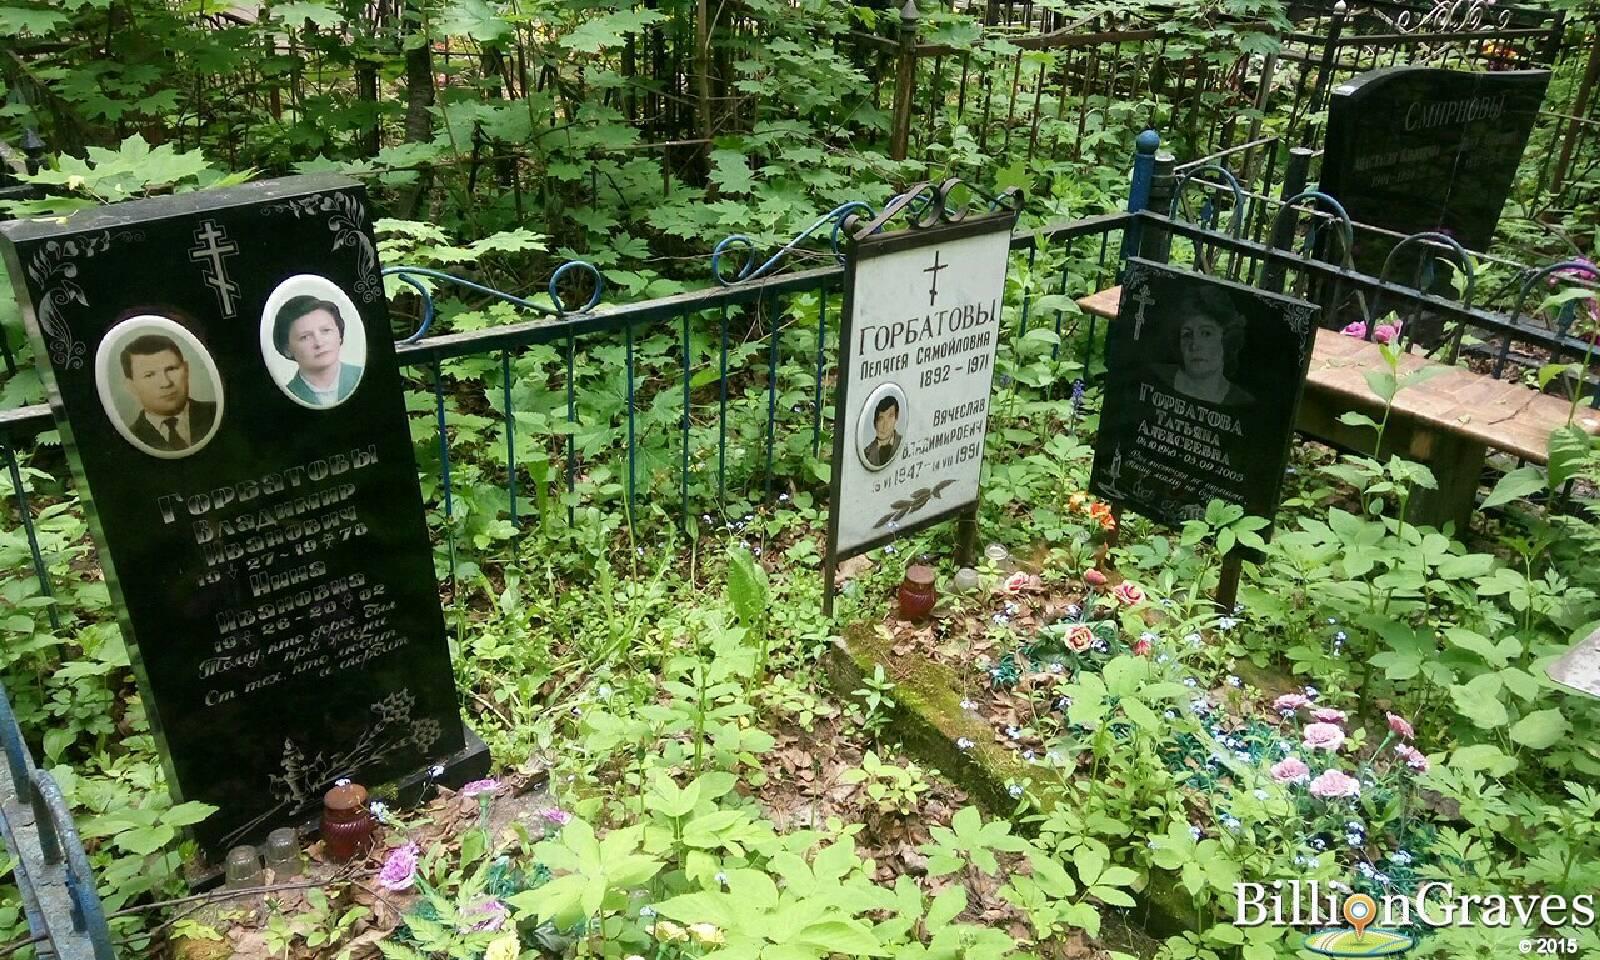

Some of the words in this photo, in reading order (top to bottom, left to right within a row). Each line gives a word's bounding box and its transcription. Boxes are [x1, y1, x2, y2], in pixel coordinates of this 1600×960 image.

[858, 299, 996, 356] ГОРБАТОВЫ
[919, 364, 950, 389] 1892
[967, 353, 990, 376] 1971
[933, 397, 986, 427] ВЯЧЕСЛАВ
[1138, 383, 1244, 437] ГОРБАТОВА
[1156, 408, 1221, 447] ТАТЬЯНА
[894, 461, 923, 486] 1947
[955, 442, 980, 466] 1991
